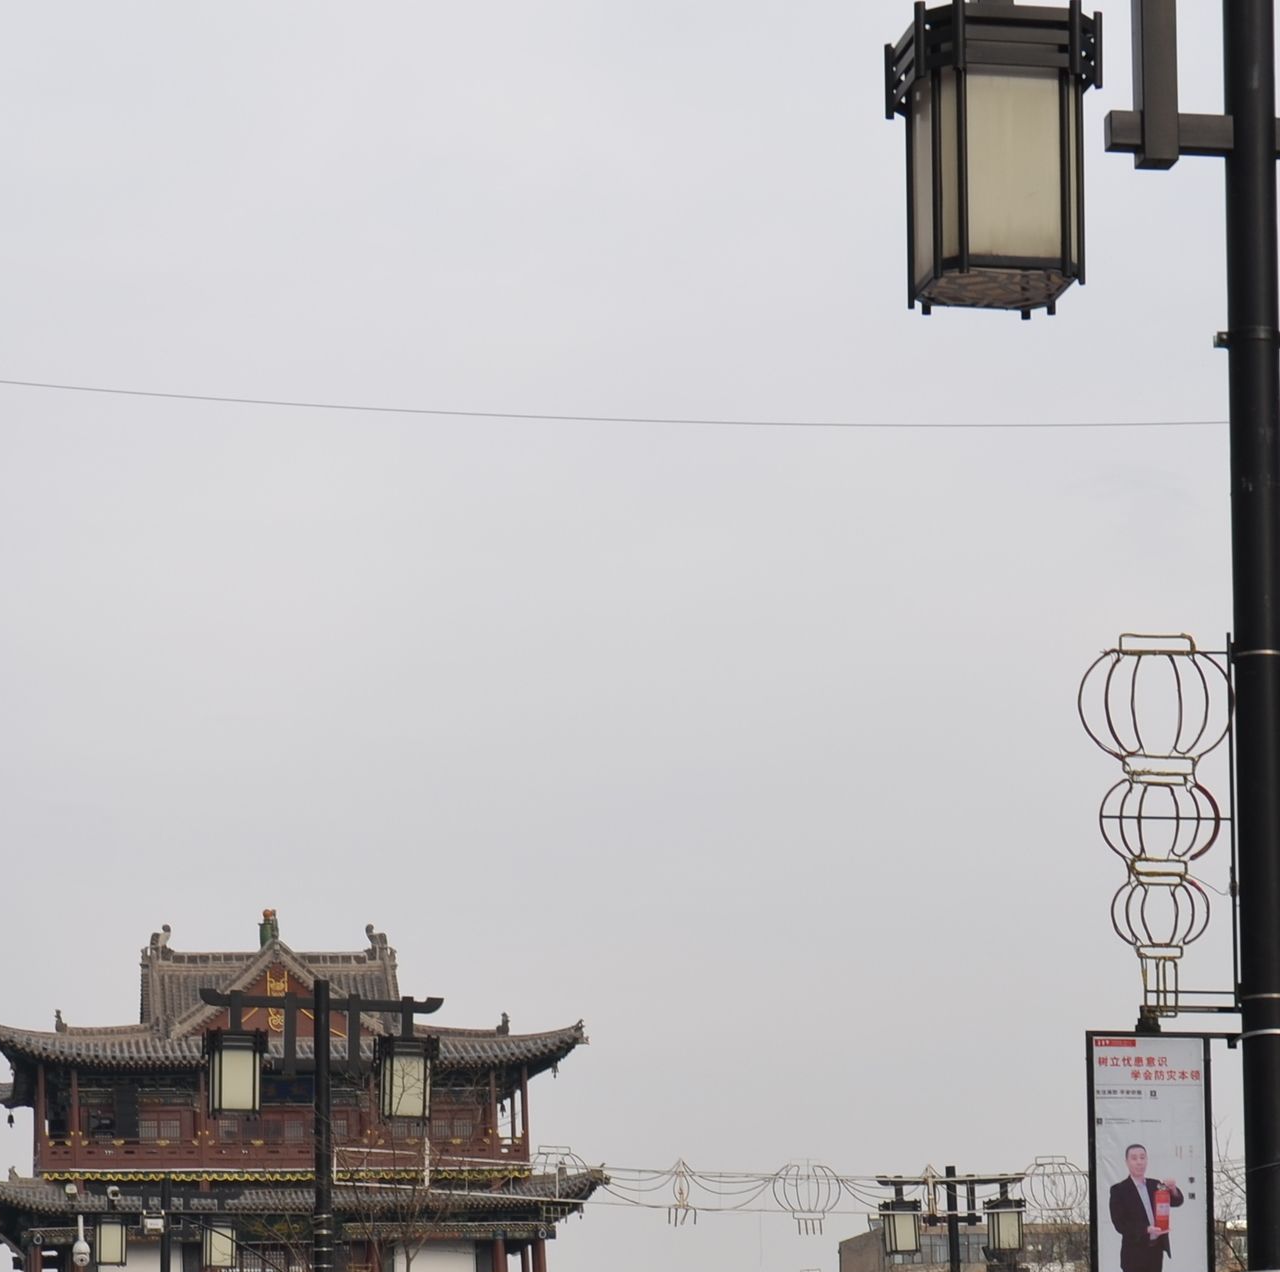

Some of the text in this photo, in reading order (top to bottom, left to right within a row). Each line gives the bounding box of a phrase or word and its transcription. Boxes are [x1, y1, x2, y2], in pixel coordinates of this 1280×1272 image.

[1098, 1056, 1168, 1067] 树立忧患意识
[1131, 1070, 1200, 1081] 学会防灾本领
